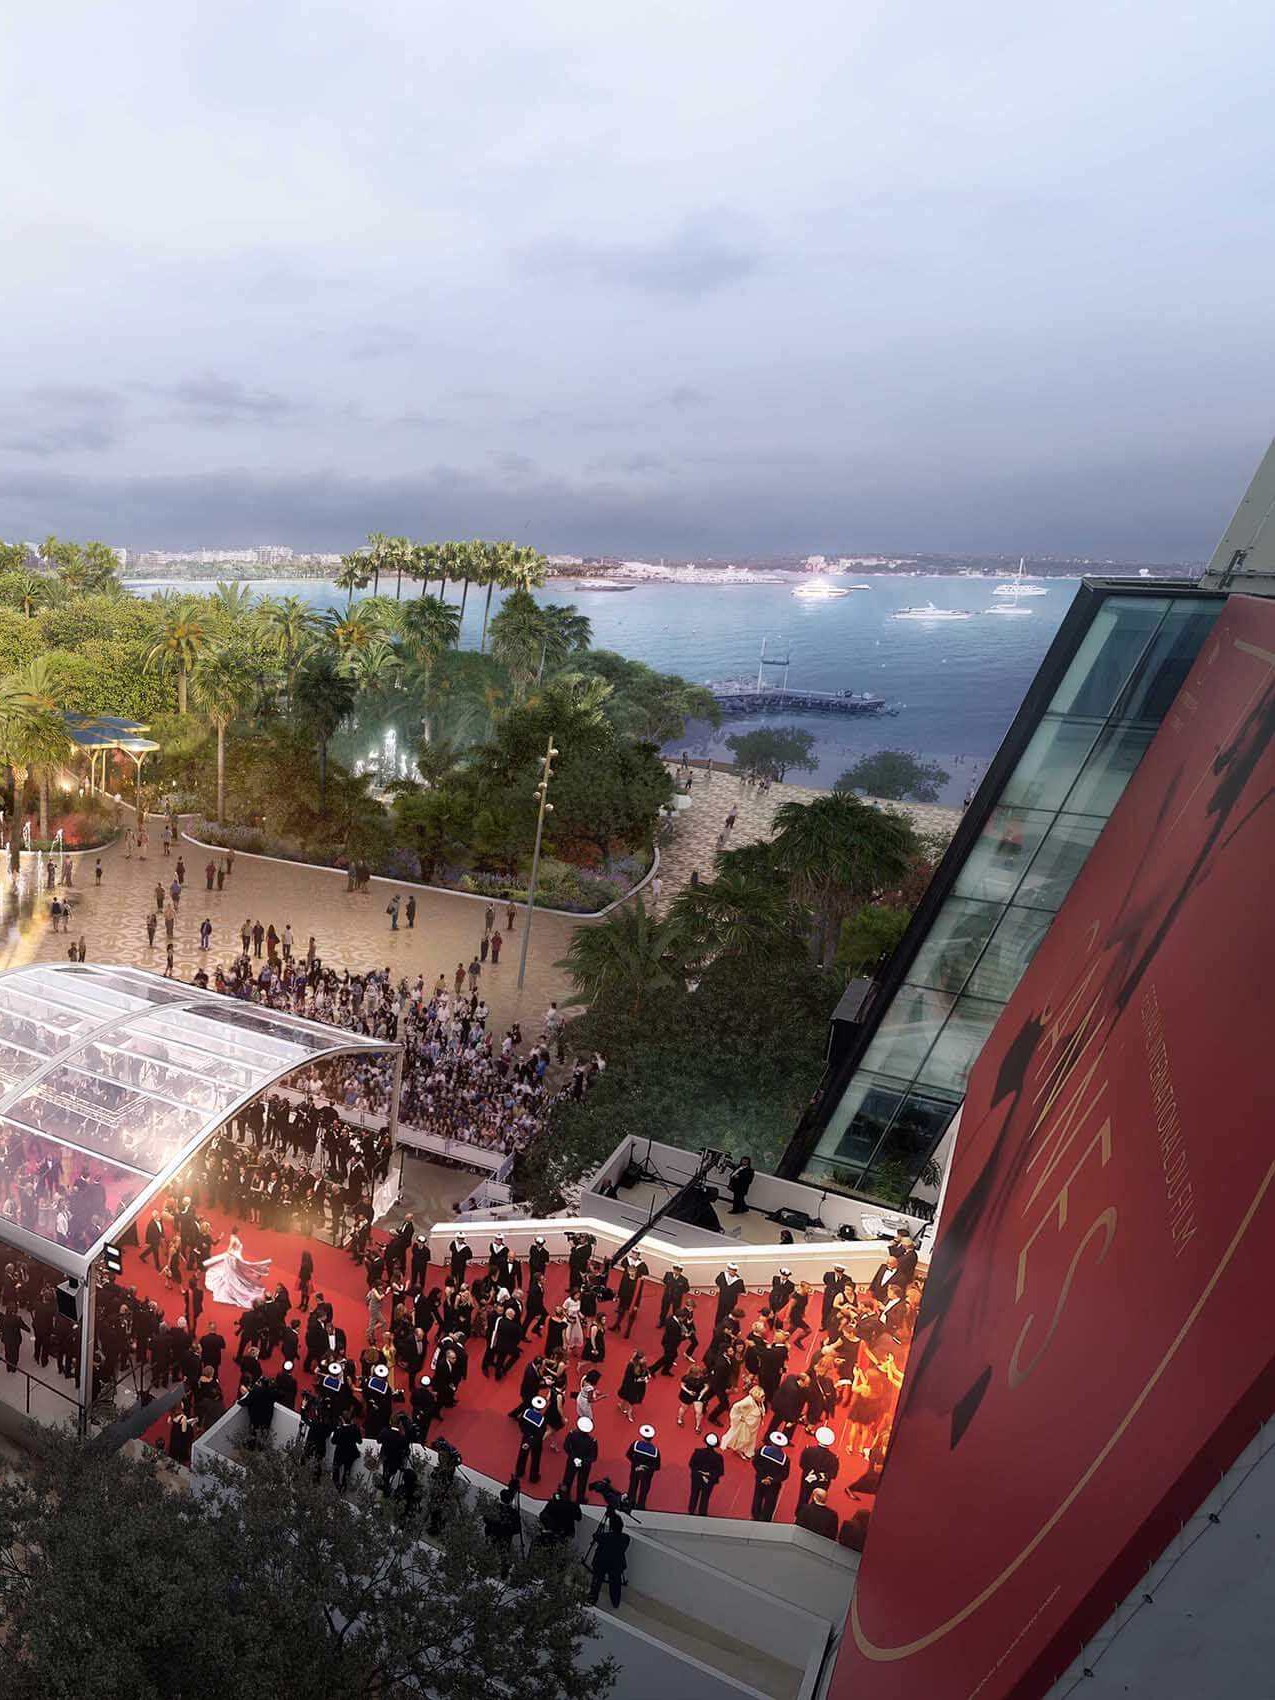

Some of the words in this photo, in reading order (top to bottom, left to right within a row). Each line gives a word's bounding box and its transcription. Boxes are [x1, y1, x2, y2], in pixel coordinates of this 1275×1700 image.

[1007, 918, 1118, 1390] CANNES
[1165, 1149, 1189, 1200] DU
[1170, 1182, 1198, 1258] FILM
